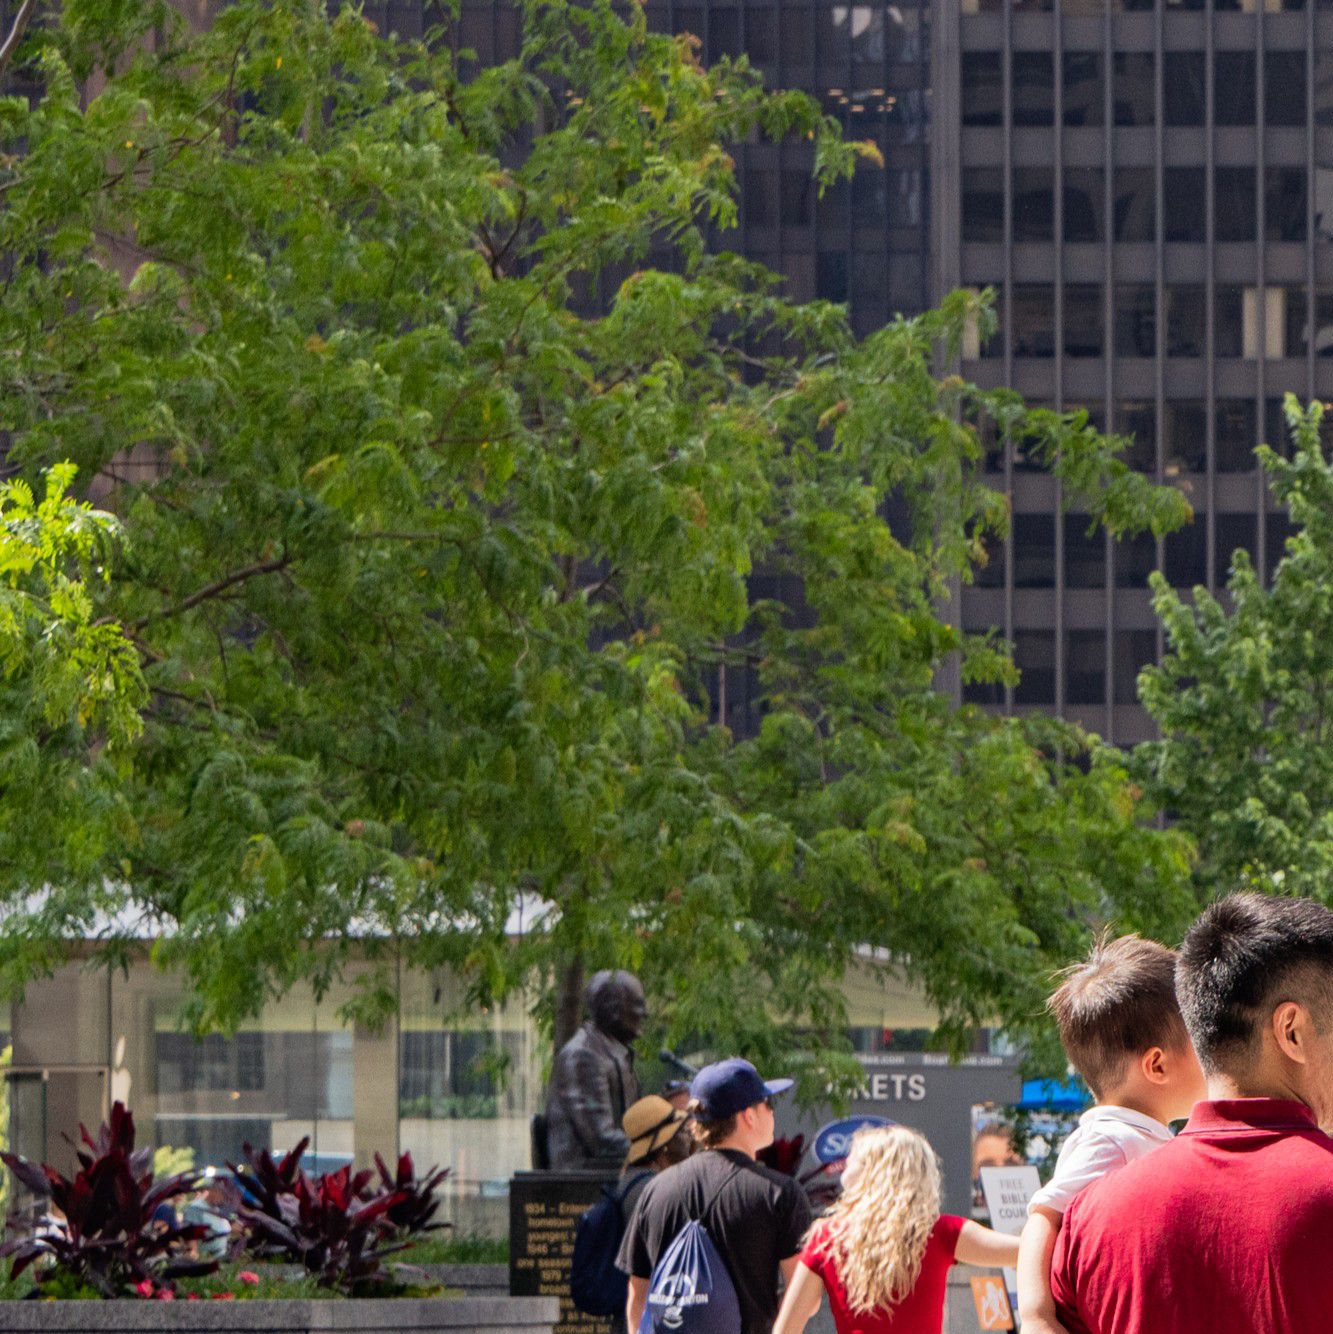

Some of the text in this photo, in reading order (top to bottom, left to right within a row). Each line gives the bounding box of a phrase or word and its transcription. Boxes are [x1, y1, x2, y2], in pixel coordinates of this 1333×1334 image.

[1000, 1179, 1024, 1189] FREE
[1002, 1193, 1028, 1203] BIBLE
[999, 1207, 1027, 1218] COUR
